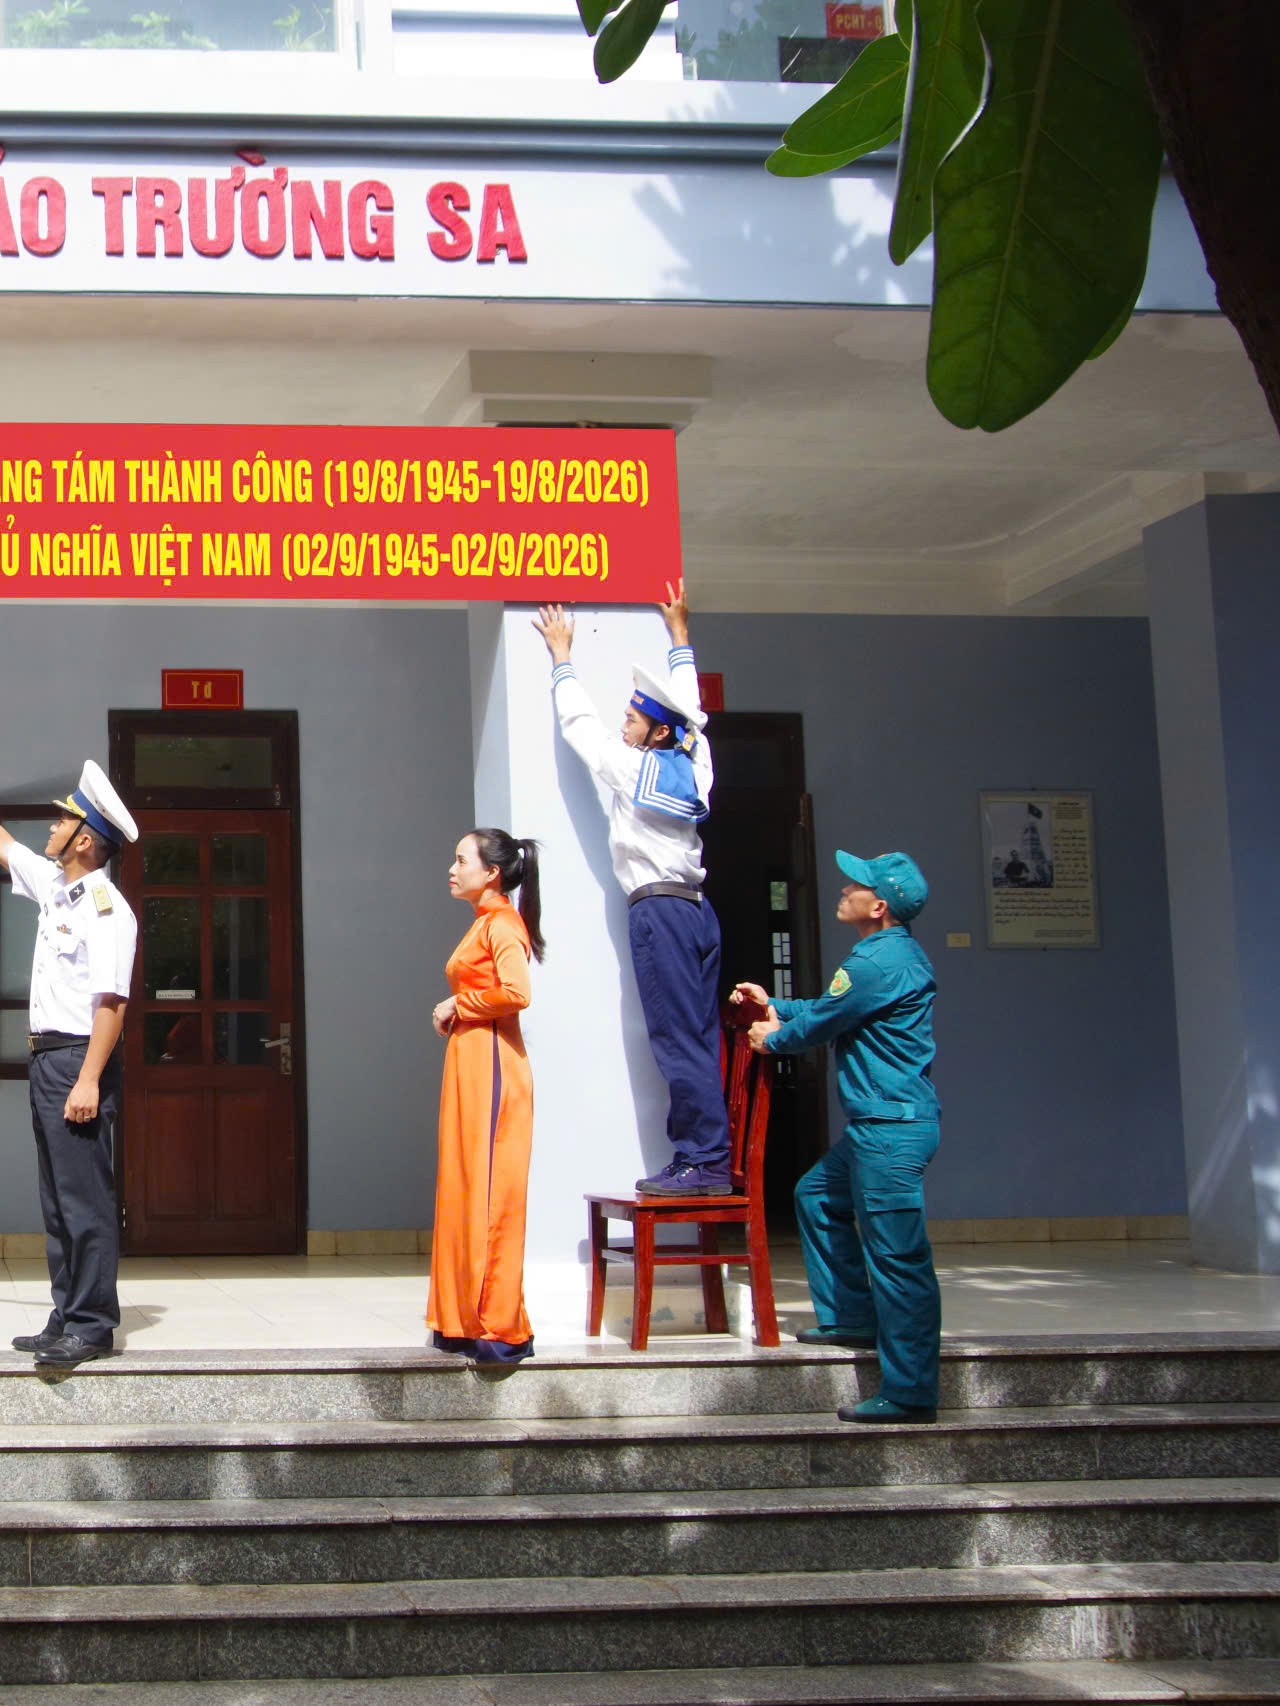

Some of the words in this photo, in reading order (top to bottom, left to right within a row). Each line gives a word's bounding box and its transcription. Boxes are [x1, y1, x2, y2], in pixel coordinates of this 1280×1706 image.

[91, 148, 395, 260] TRƯỜNG
[426, 182, 528, 263] SA
[51, 450, 115, 503] TÁM
[124, 450, 222, 503] THÀNH
[232, 450, 313, 503] CÔNG
[323, 458, 649, 508] (19/8/1945-19/8/2026)
[29, 524, 122, 577] NGHĨA
[129, 523, 193, 587] VIỆT
[201, 532, 271, 576] NAM
[282, 532, 609, 582] (02/9/1945-02/9/2026)
